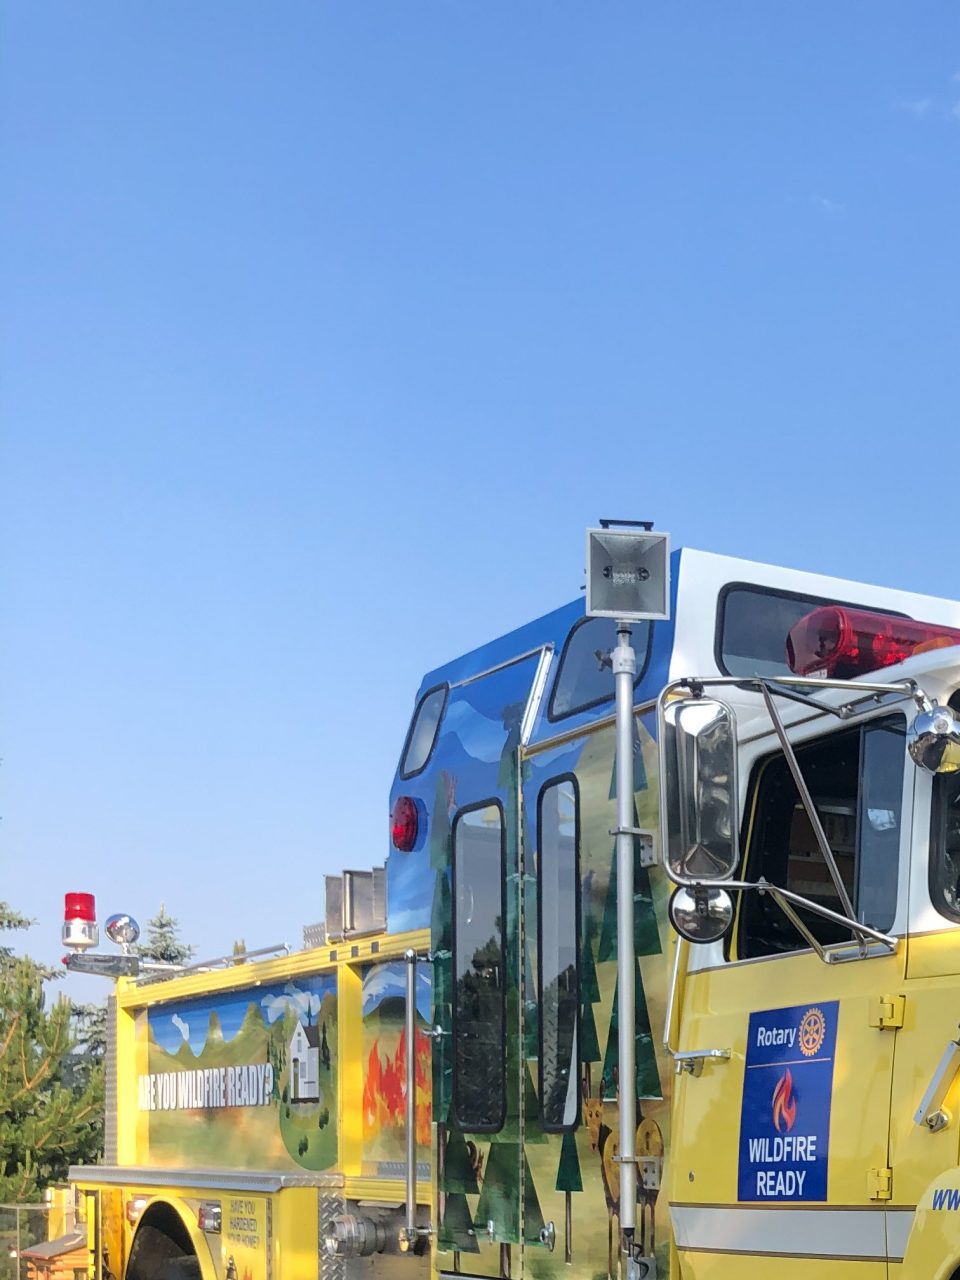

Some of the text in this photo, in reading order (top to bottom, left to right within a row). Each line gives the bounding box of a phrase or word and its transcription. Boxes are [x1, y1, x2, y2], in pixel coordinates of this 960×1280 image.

[756, 1026, 797, 1048] Rotary
[138, 1062, 274, 1111] ARE YOU WILDFIRE READY?
[748, 1135, 817, 1163] WILDFIRE
[756, 1170, 807, 1196] READY
